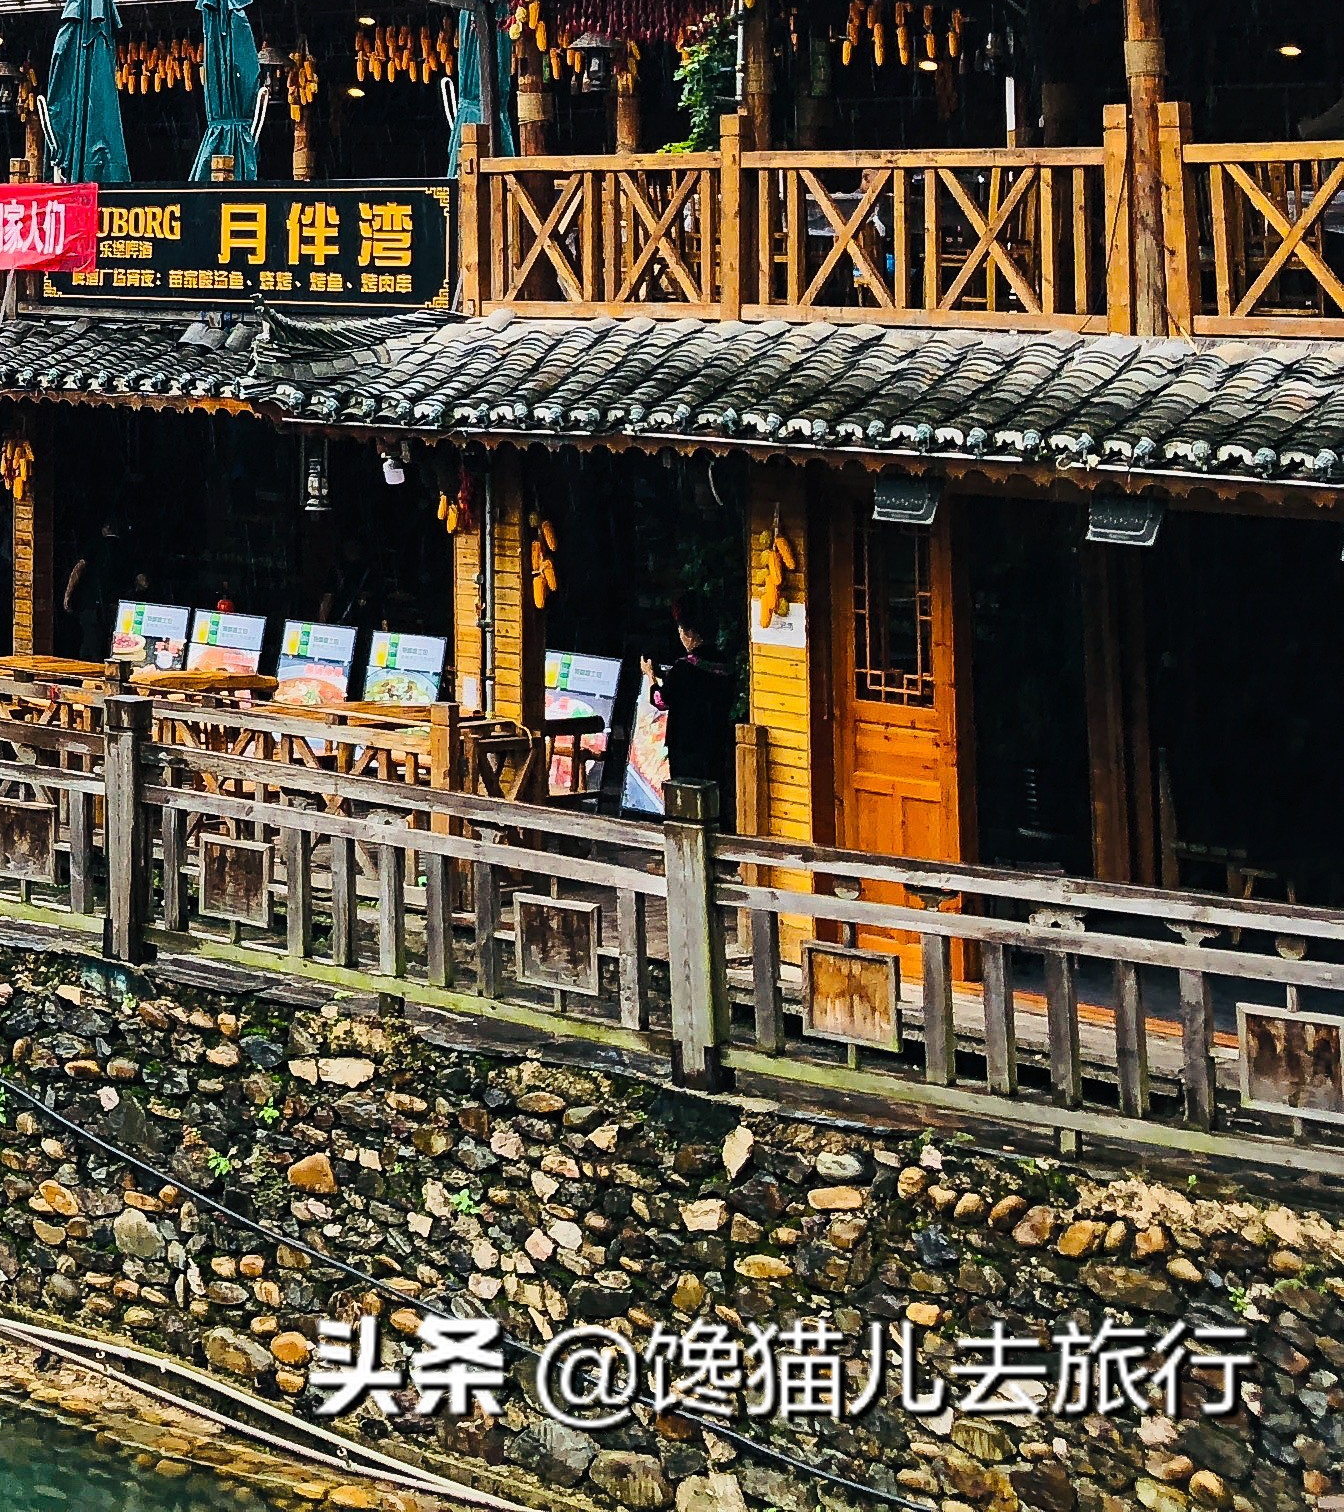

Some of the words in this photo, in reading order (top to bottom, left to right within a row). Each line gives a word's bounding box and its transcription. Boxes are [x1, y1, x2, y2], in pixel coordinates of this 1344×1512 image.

[95, 203, 181, 240] UBORG
[218, 201, 413, 267] 月伴湾
[99, 239, 153, 259] 乐堡啤酒
